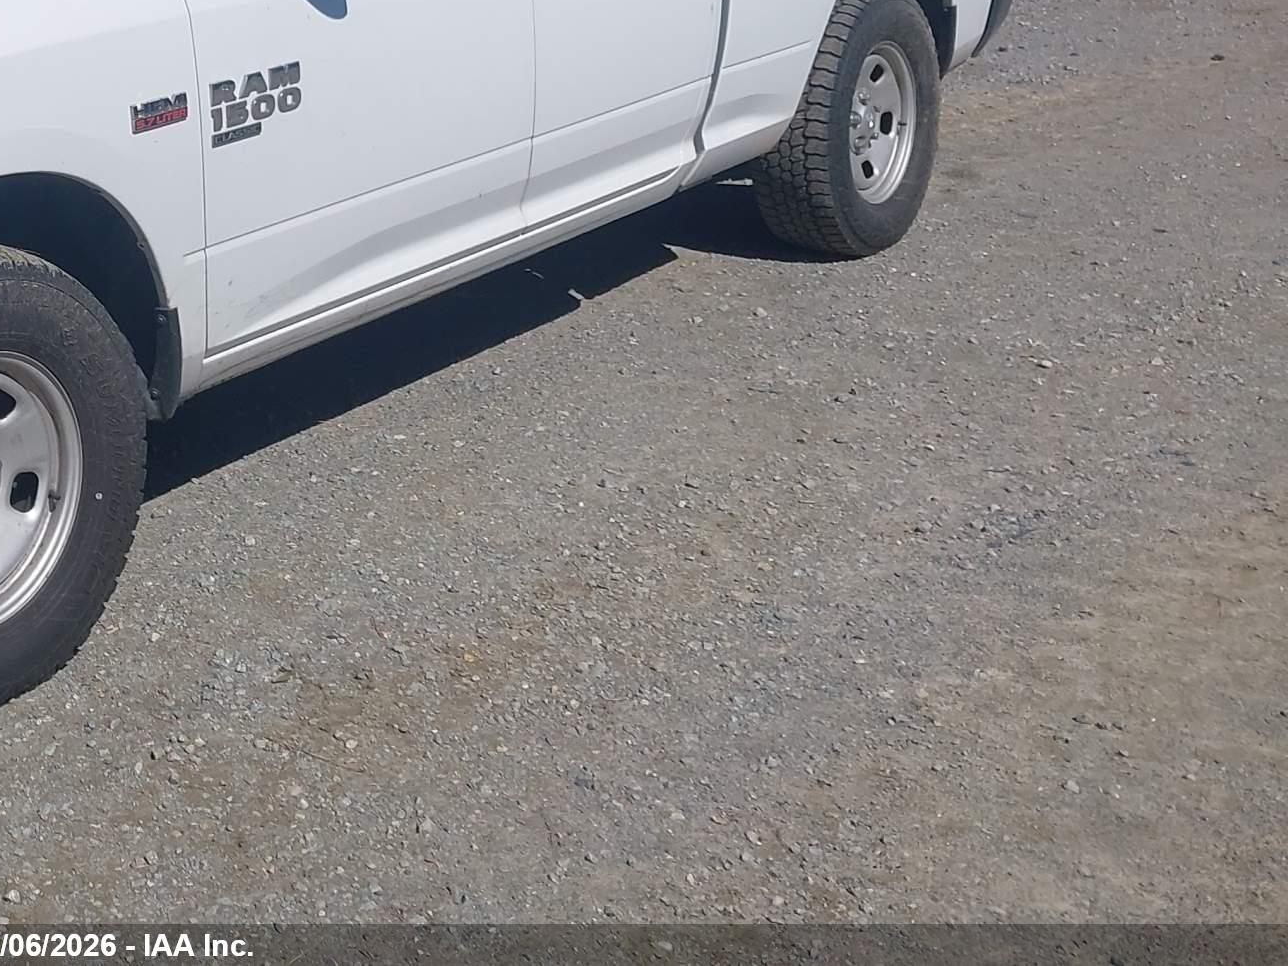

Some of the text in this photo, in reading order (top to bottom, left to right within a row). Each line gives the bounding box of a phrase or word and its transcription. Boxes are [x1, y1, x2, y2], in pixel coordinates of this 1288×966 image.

[209, 60, 301, 108] RAM
[136, 108, 186, 131] 5.7 LITER
[210, 87, 302, 133] 1500
